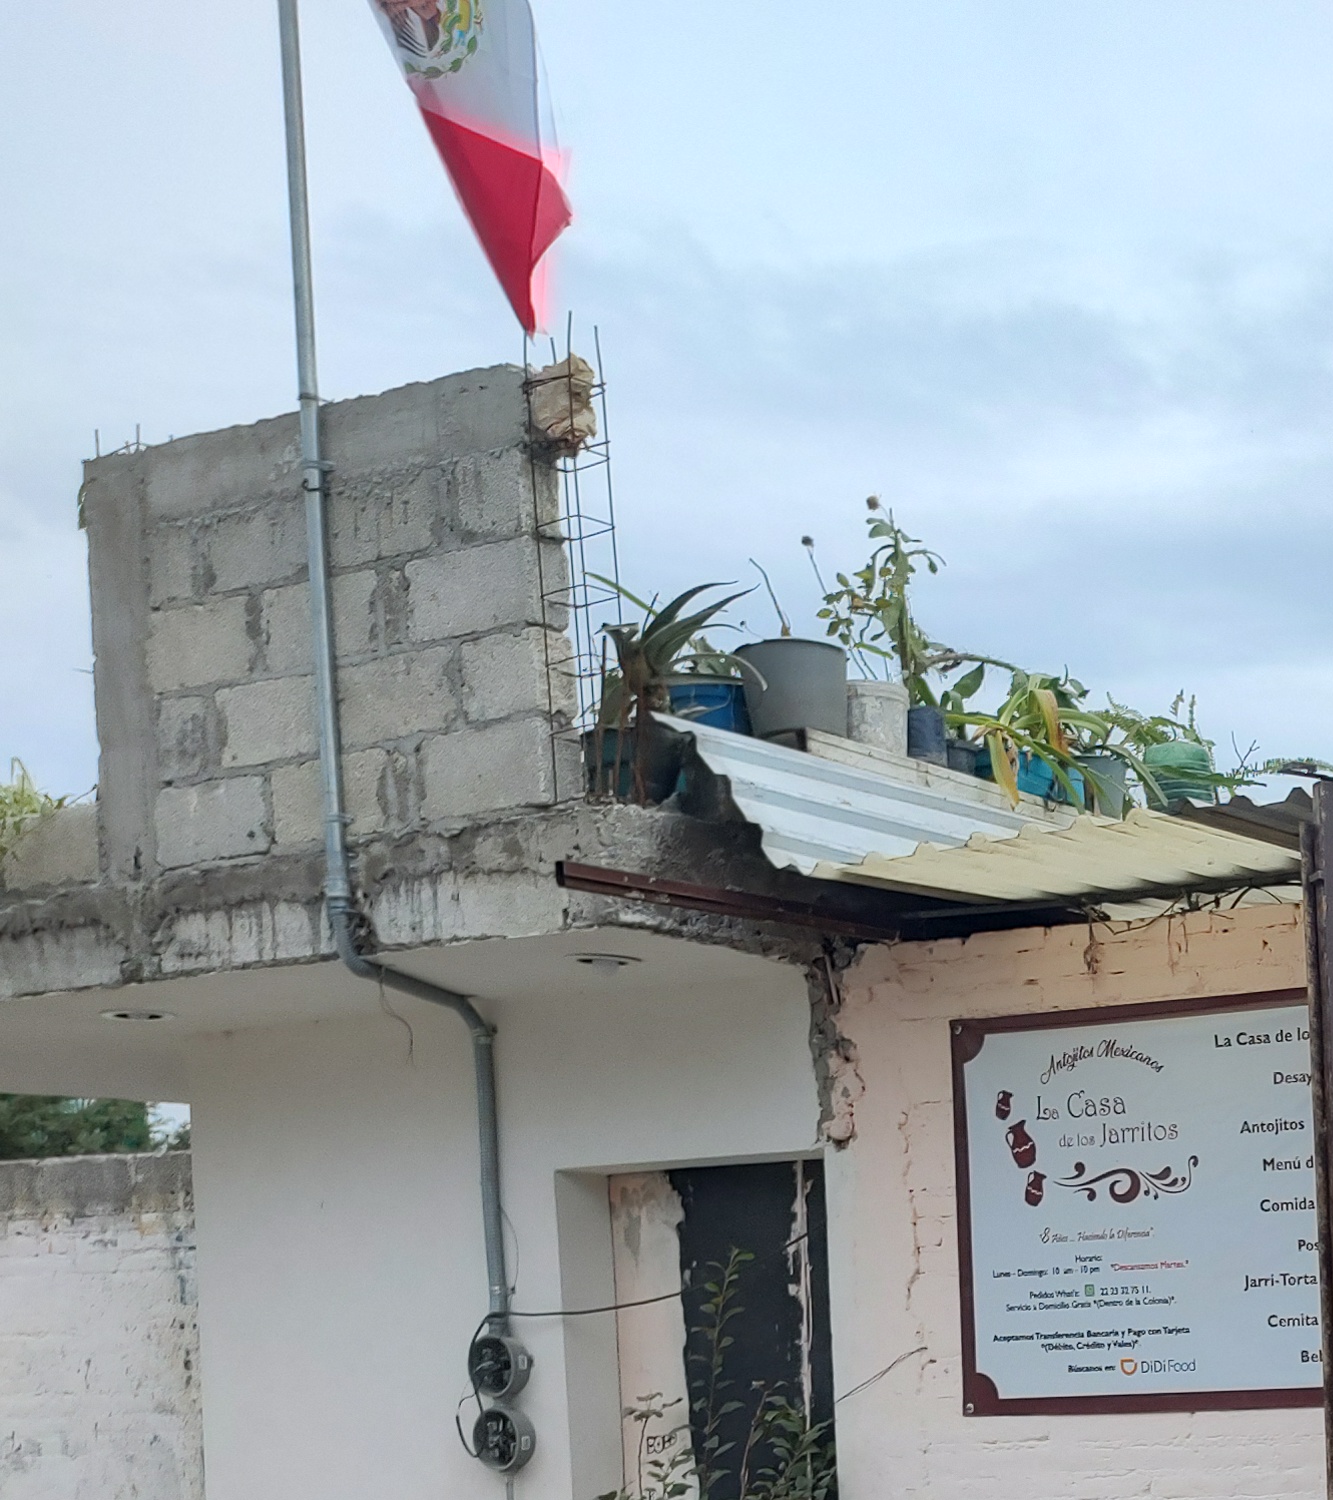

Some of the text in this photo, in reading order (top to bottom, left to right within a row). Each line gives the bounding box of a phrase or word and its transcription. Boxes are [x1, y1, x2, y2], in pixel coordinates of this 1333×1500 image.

[1214, 1027, 1310, 1048] La Casa de lo
[1040, 1039, 1165, 1085] Antojitos Mexicanos
[1273, 1071, 1312, 1086] Desay
[1036, 1089, 1126, 1121] La Casa
[1058, 1121, 1179, 1148] de los Jarritos
[1240, 1118, 1305, 1135] Antojitos
[1263, 1155, 1314, 1171] Menú d
[1260, 1197, 1315, 1212] Comida
[1298, 1239, 1319, 1251] Pos
[1244, 1274, 1317, 1292] Jarri-Torta
[1267, 1313, 1319, 1328] Cemita
[1301, 1350, 1323, 1363] Be
